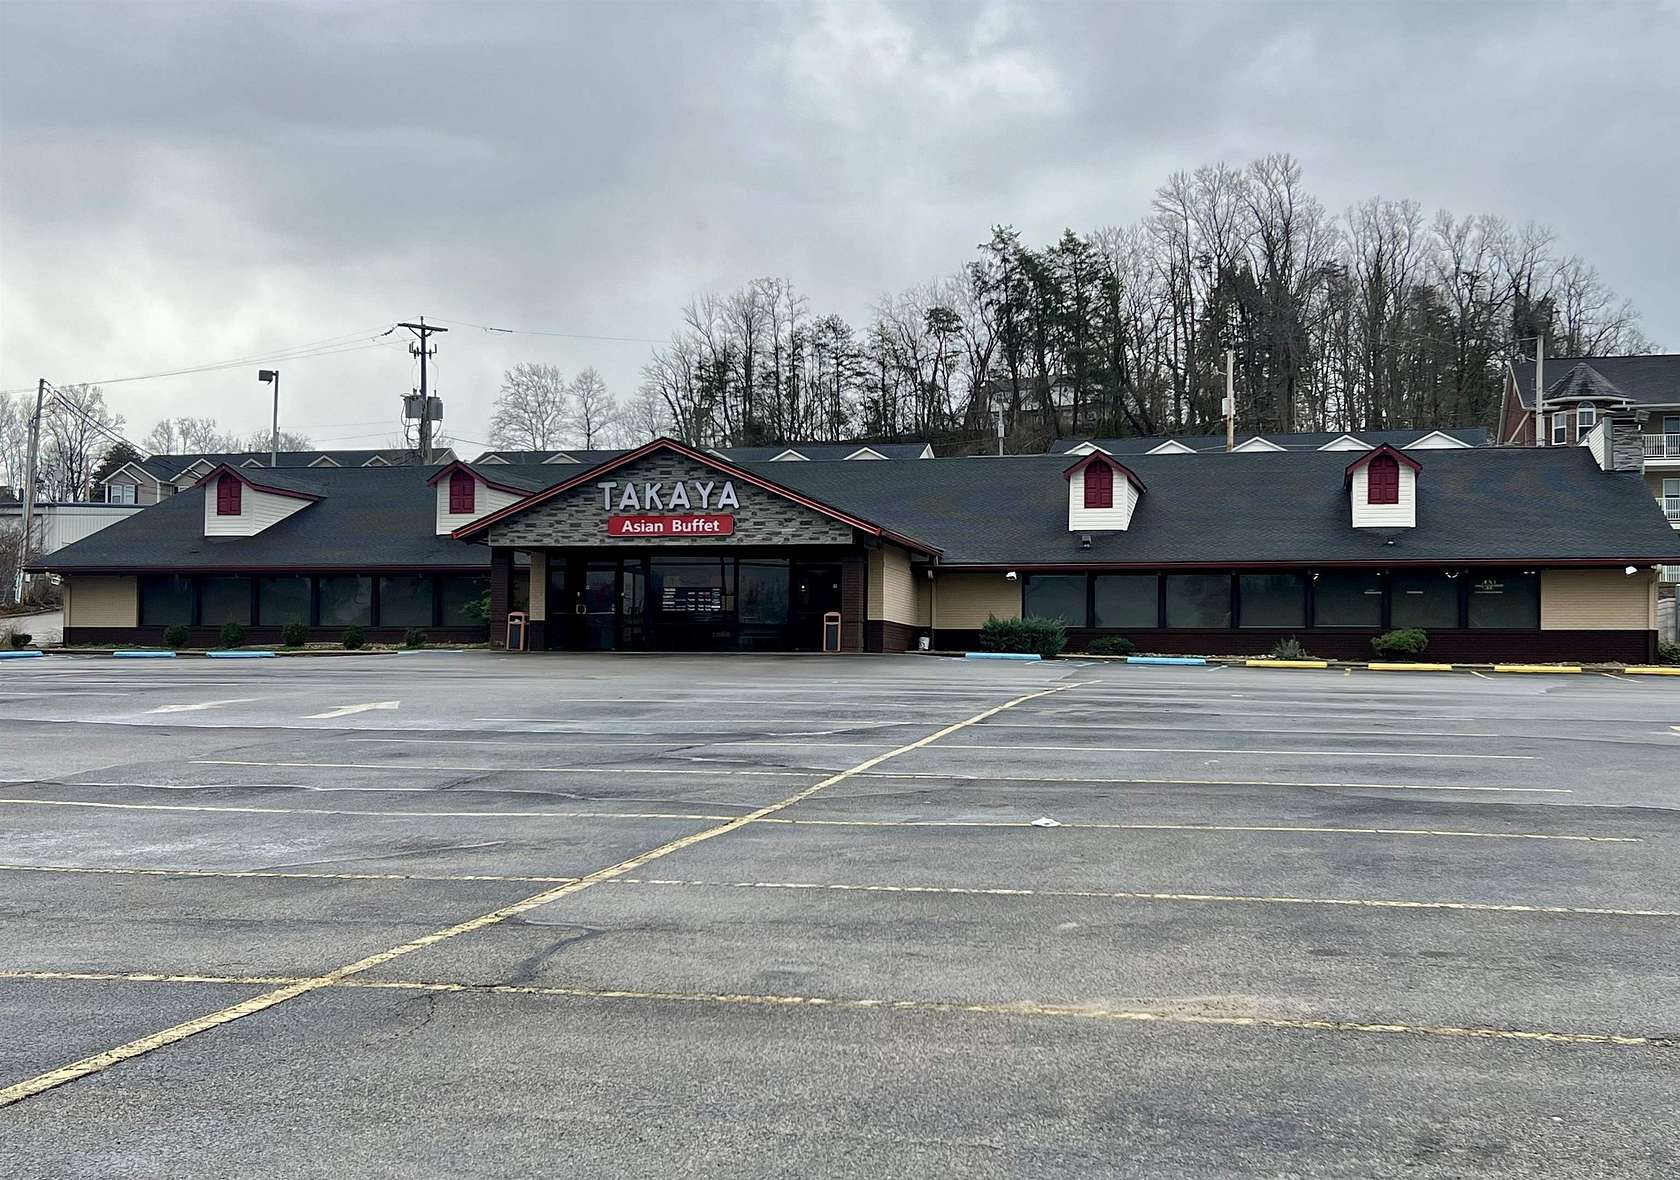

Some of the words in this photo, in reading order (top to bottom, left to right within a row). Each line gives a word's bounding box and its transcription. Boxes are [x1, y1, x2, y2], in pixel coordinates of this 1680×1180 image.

[598, 480, 740, 510] TAKAYA
[621, 520, 664, 533] Asian
[672, 519, 720, 532] Buffet
